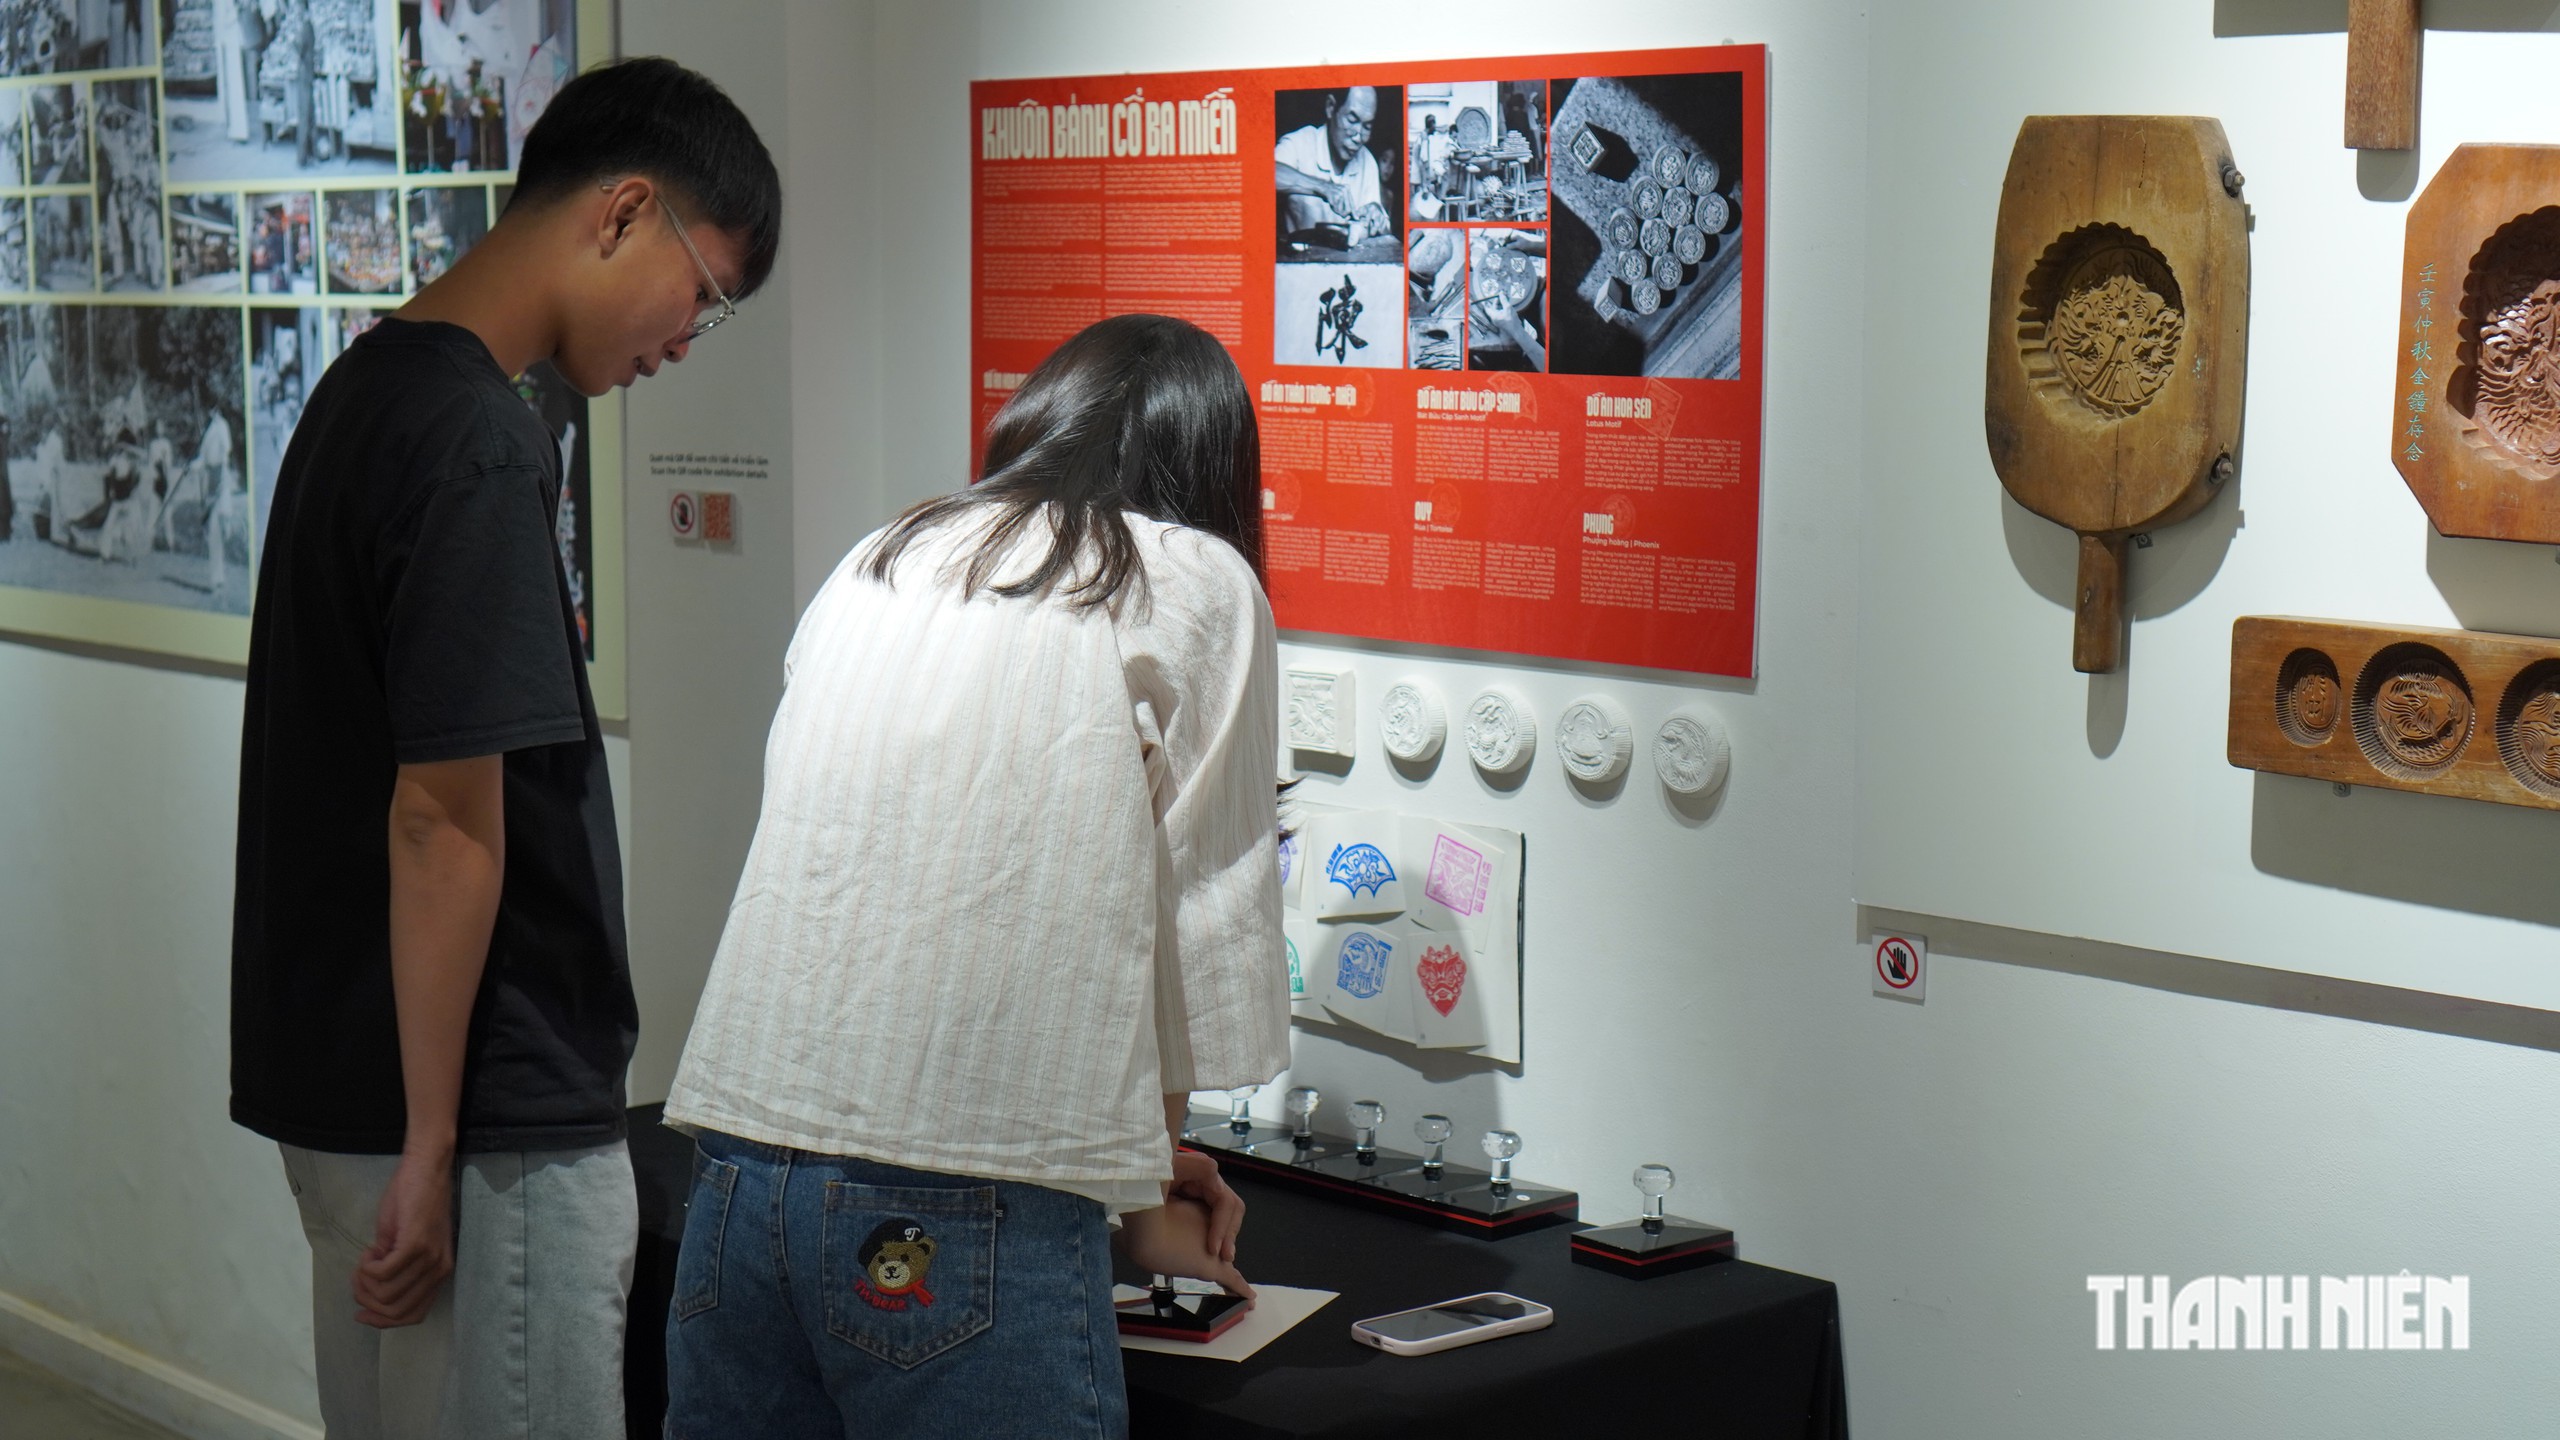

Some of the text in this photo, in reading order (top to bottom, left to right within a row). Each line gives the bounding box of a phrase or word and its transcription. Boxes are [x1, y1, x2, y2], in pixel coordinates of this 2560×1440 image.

[1145, 101, 1176, 157] BA
[1315, 273, 1369, 365] 陳
[1614, 397, 1633, 419] HOA
[1634, 397, 1652, 419] SEN
[1633, 540, 1660, 549] Phoenix
